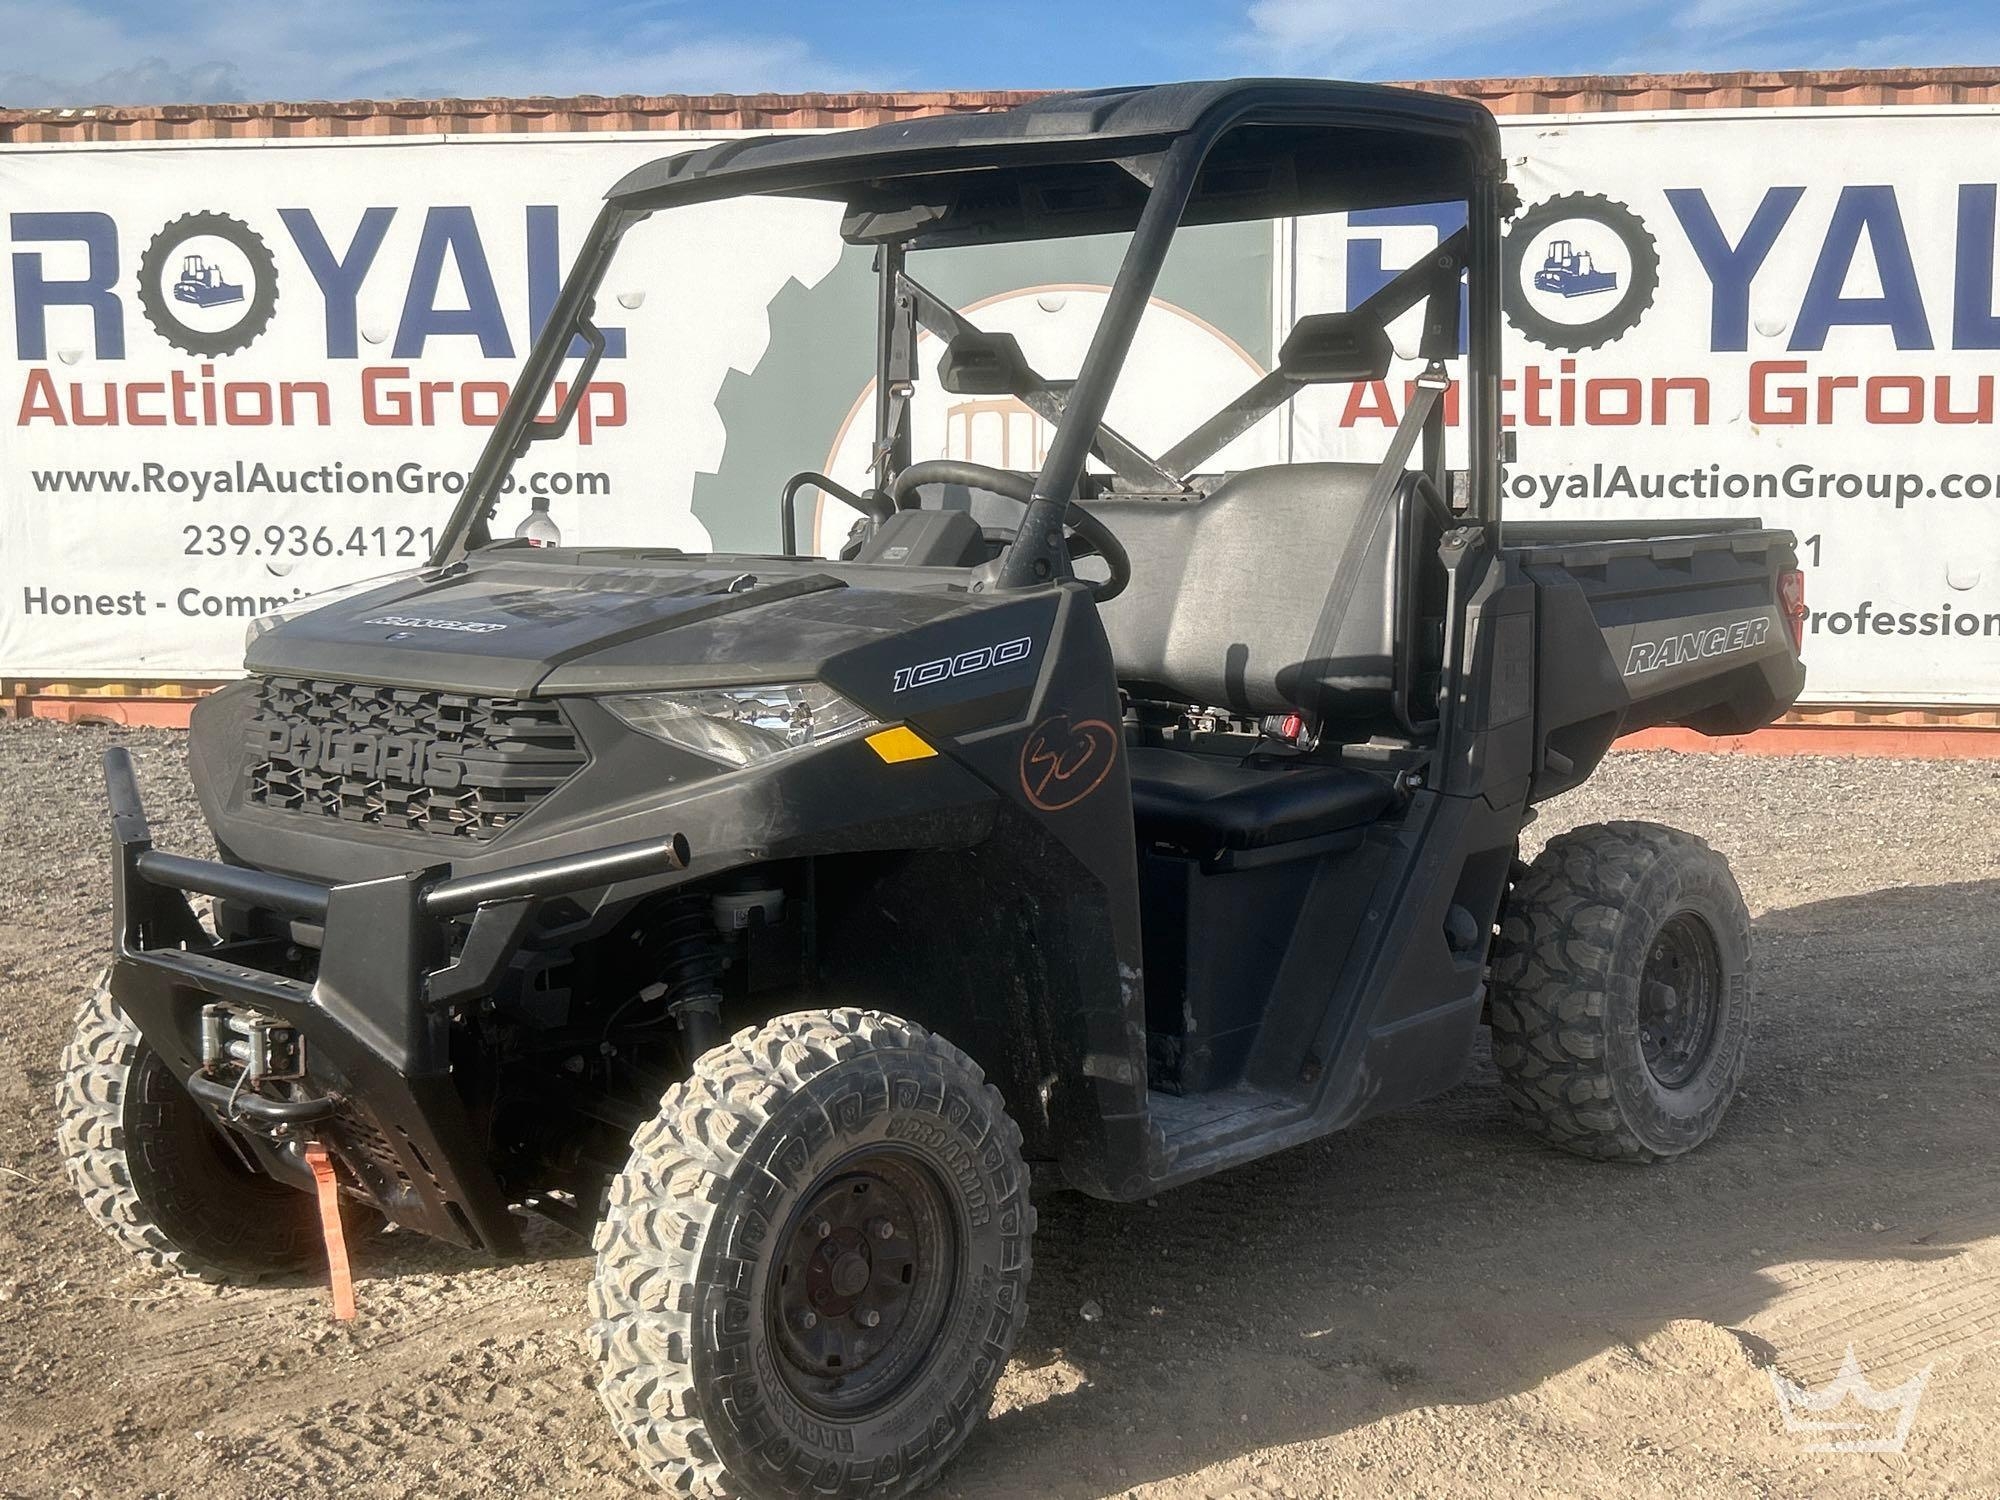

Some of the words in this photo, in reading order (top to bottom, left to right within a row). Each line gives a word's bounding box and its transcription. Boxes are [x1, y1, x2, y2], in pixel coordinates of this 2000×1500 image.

[10, 205, 627, 361] ROYAL
[17, 364, 331, 427] Auction
[1339, 359, 1709, 428] Aution
[32, 460, 611, 503] www.RoyalAuctionGro.com
[1501, 463, 2000, 510] oyalAuctionGroup.co
[183, 524, 436, 557] 239.936.4121
[23, 587, 146, 616] Honest
[177, 587, 312, 617] Comm
[893, 636, 1032, 693] 1000
[1623, 616, 1770, 677] RANGER
[262, 719, 465, 790] POLARIS
[937, 1139, 992, 1228] ARMOR
